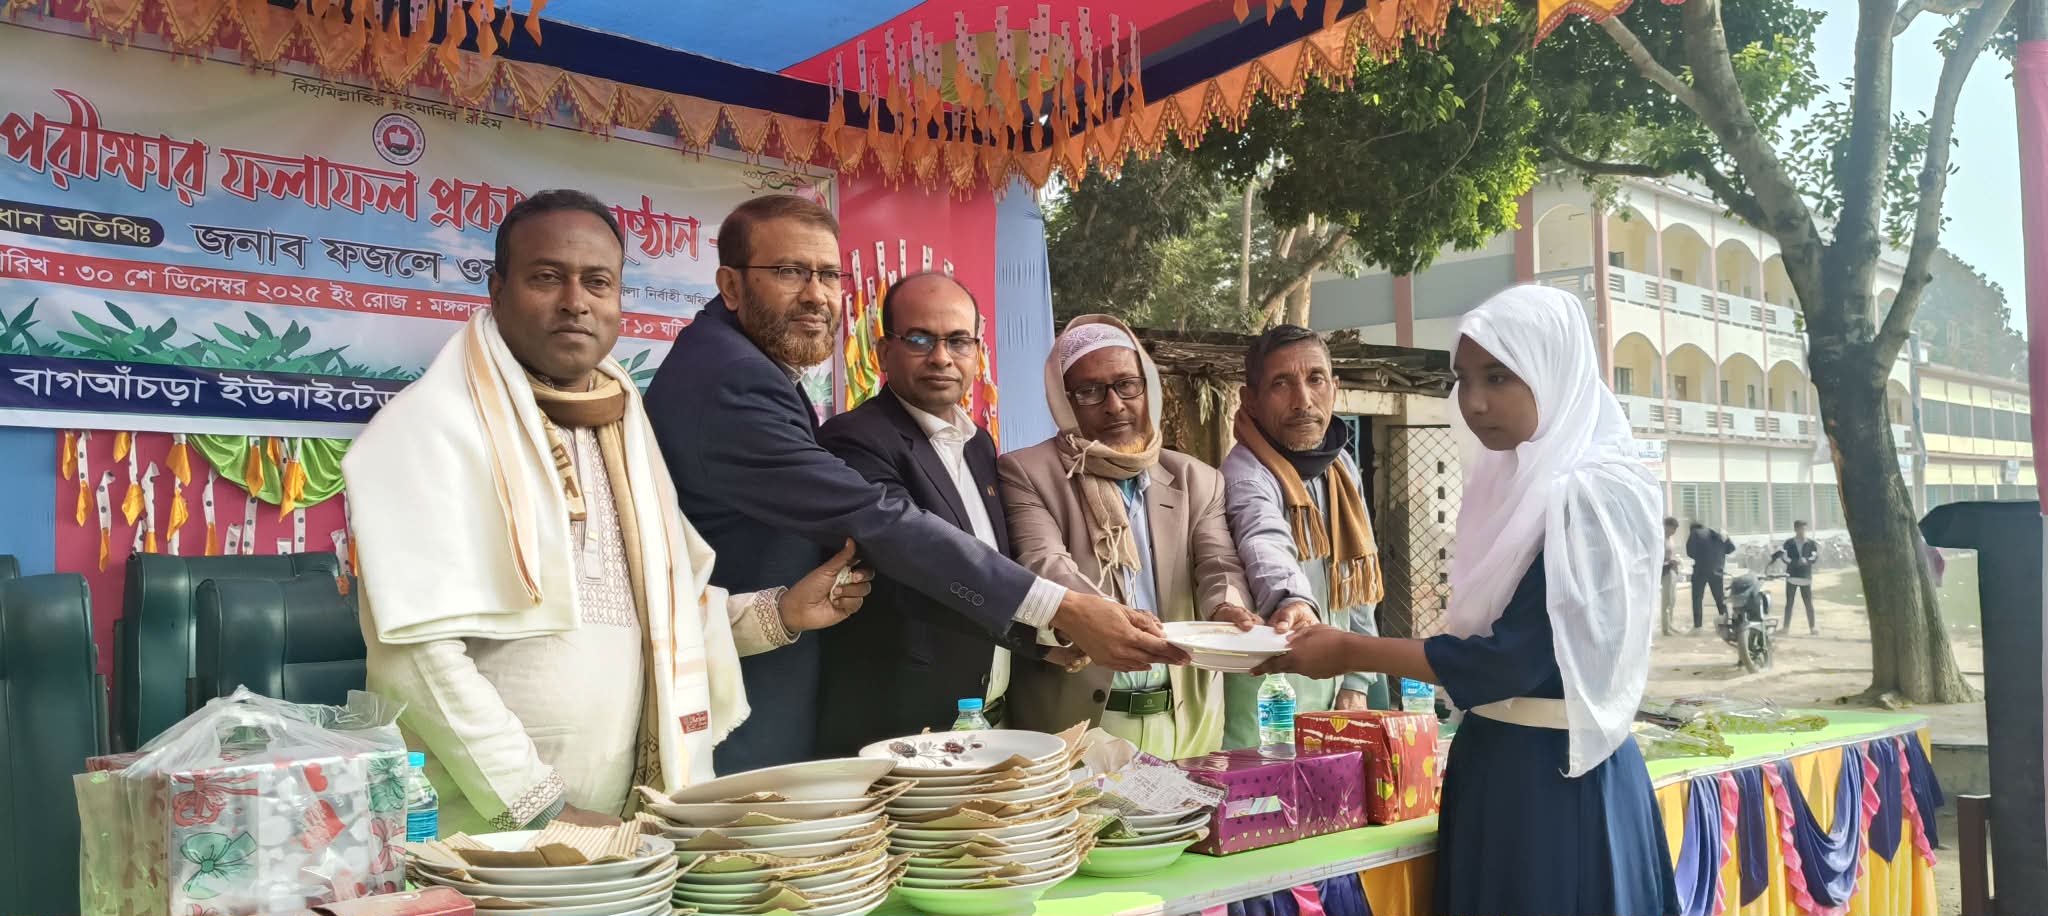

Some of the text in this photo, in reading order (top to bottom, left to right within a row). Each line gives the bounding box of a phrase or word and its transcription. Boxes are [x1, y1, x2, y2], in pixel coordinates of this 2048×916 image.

[0, 88, 208, 206] পরীক্ষার
[219, 147, 419, 222] ফলাফল
[427, 177, 528, 232] প্রকা
[50, 212, 150, 244] অতিথিঃ
[188, 223, 313, 270] জনাব
[320, 237, 446, 284] ফজলে
[0, 248, 50, 276] ারিখ
[75, 265, 113, 283] ৩০
[125, 269, 156, 289] শে
[162, 267, 248, 297] ডিসেম্বর
[256, 281, 320, 302] ২০২৫
[329, 283, 356, 307] ইং
[362, 289, 409, 311] রোজ
[634, 319, 655, 334] ১০
[10, 366, 207, 407] বাগআঁচড়া
